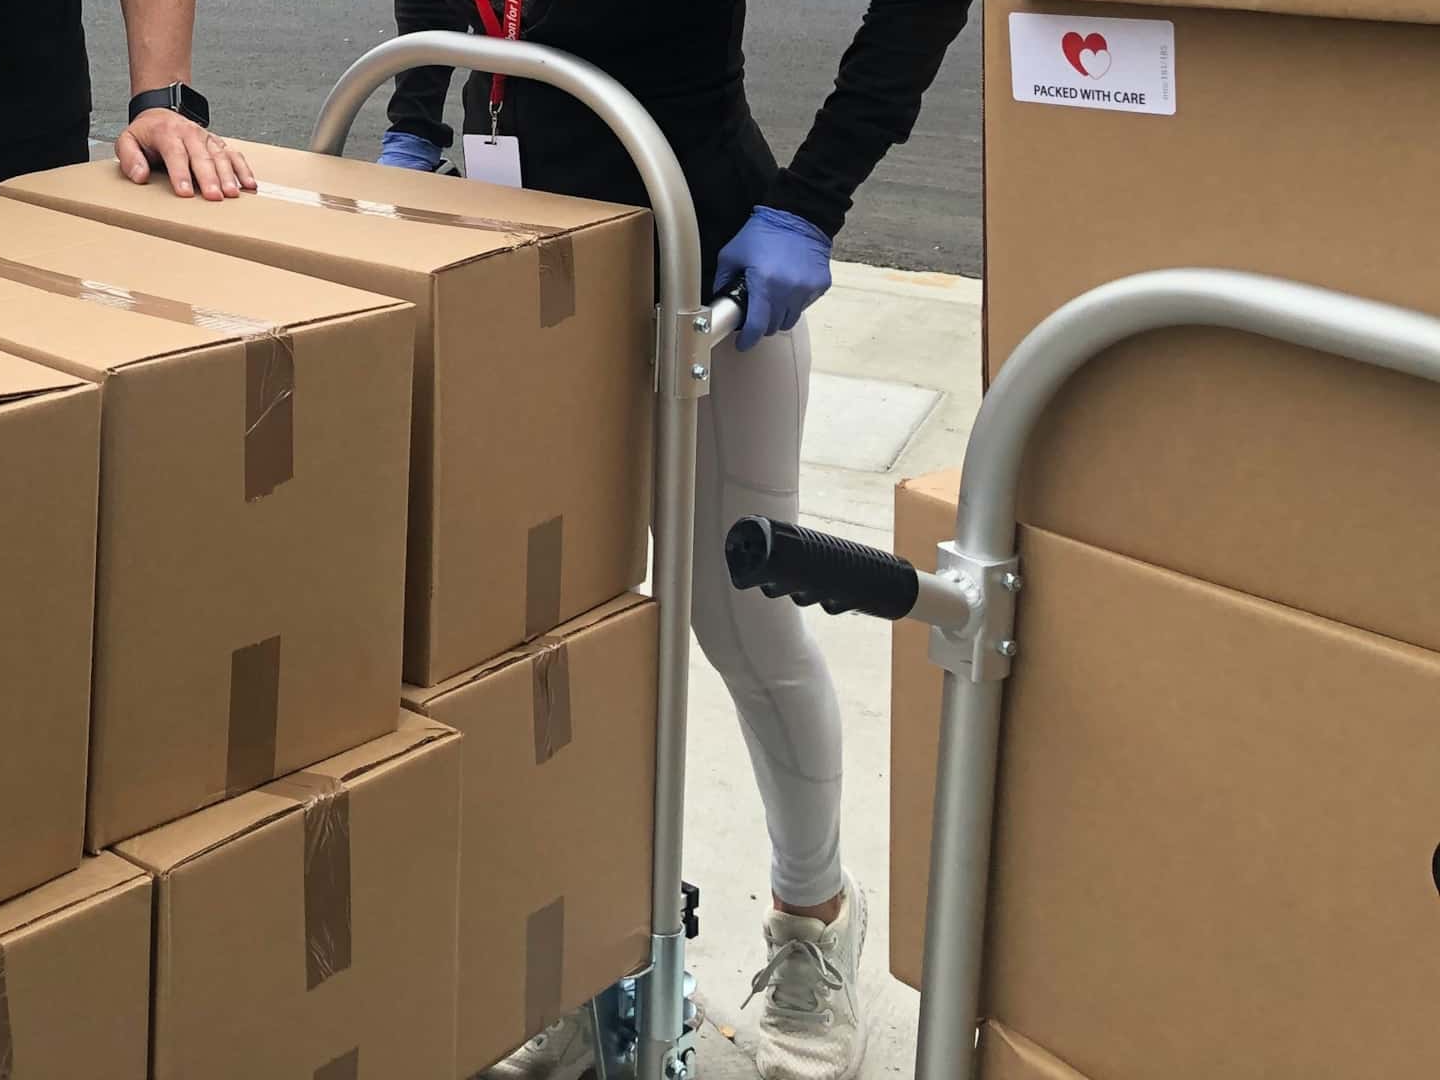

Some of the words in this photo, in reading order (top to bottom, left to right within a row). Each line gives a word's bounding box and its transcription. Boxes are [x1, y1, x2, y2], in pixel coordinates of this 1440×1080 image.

[506, 4, 518, 22] for
[1034, 84, 1078, 99] PACKED
[1079, 88, 1111, 102] WITH
[1113, 91, 1146, 104] CARE
